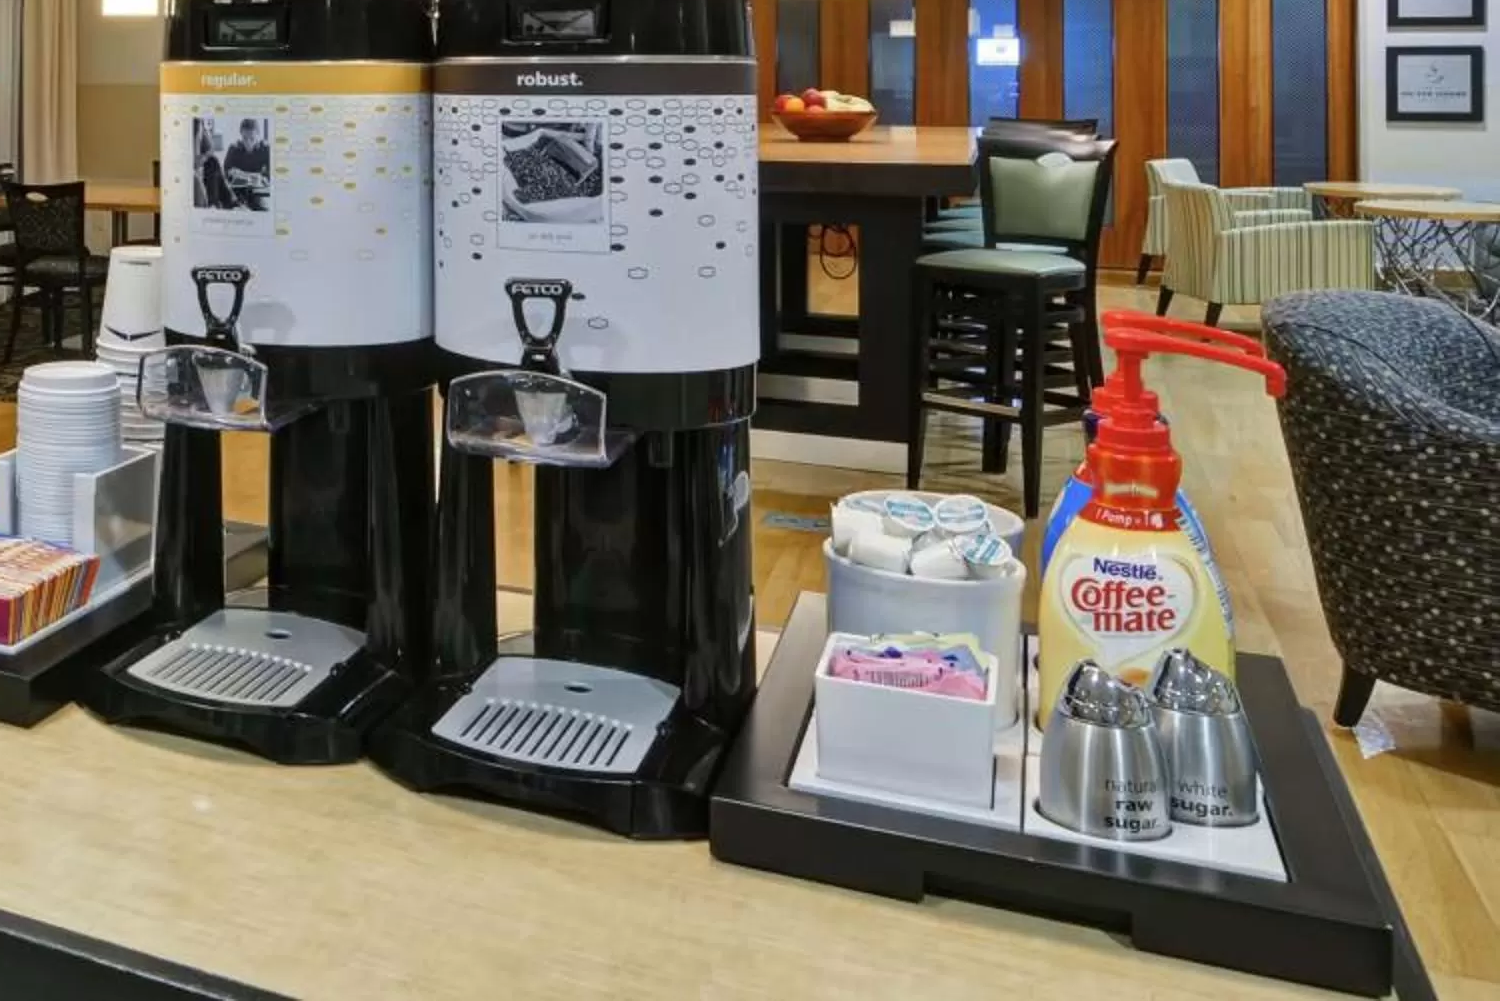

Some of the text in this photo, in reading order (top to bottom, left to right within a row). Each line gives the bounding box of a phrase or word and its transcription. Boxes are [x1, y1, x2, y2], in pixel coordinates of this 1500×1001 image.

[517, 71, 583, 86] robust.
[197, 270, 243, 280] FETCO
[512, 284, 562, 295] FETCO
[1093, 608, 1176, 632] mate
[1179, 780, 1229, 798] white
[1115, 800, 1153, 812] raw
[1170, 796, 1234, 818] sugar.
